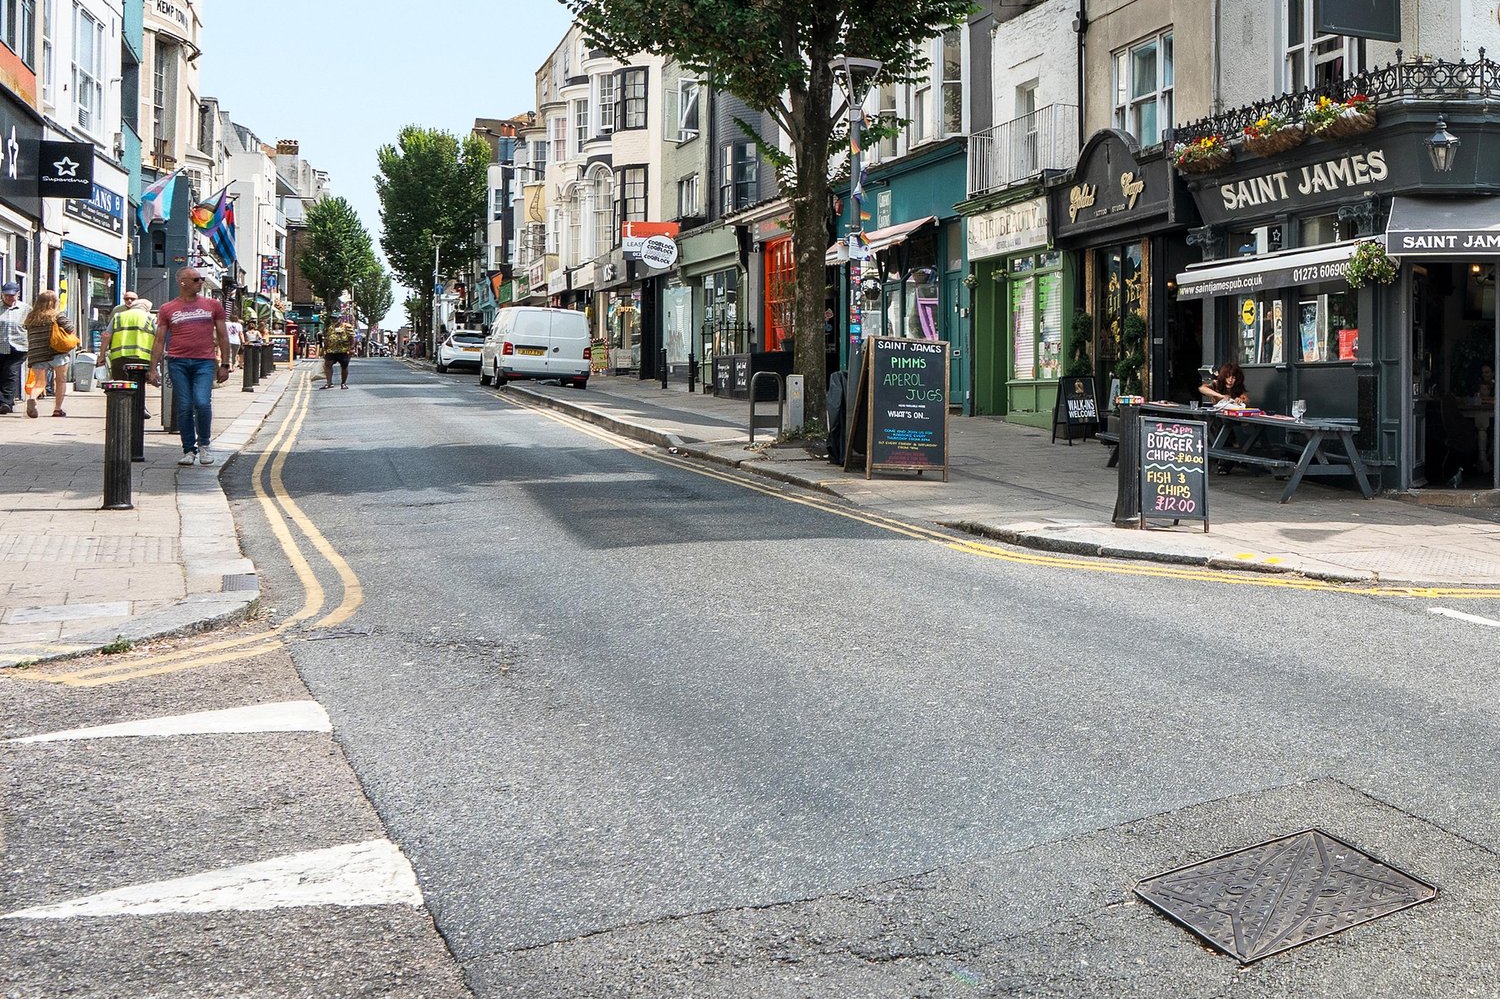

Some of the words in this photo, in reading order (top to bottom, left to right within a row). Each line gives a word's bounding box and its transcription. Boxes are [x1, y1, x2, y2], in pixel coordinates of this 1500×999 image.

[42, 176, 89, 184] Superdrug
[1221, 172, 1289, 210] SAINT
[1298, 150, 1389, 194] JAMES
[1403, 235, 1457, 249] SAINT
[1294, 266, 1318, 282] 01273
[878, 341, 907, 350] SAINT
[910, 344, 942, 353] JAMES
[883, 373, 925, 386] APEROL
[906, 389, 943, 402] JUGS
[1067, 399, 1095, 412] WALK-INS
[888, 410, 912, 419] WHAT'S
[1068, 409, 1096, 418] WELCOME
[1147, 433, 1193, 452] BURGER
[1147, 471, 1171, 483] FISH
[1157, 485, 1190, 499] CHIPS
